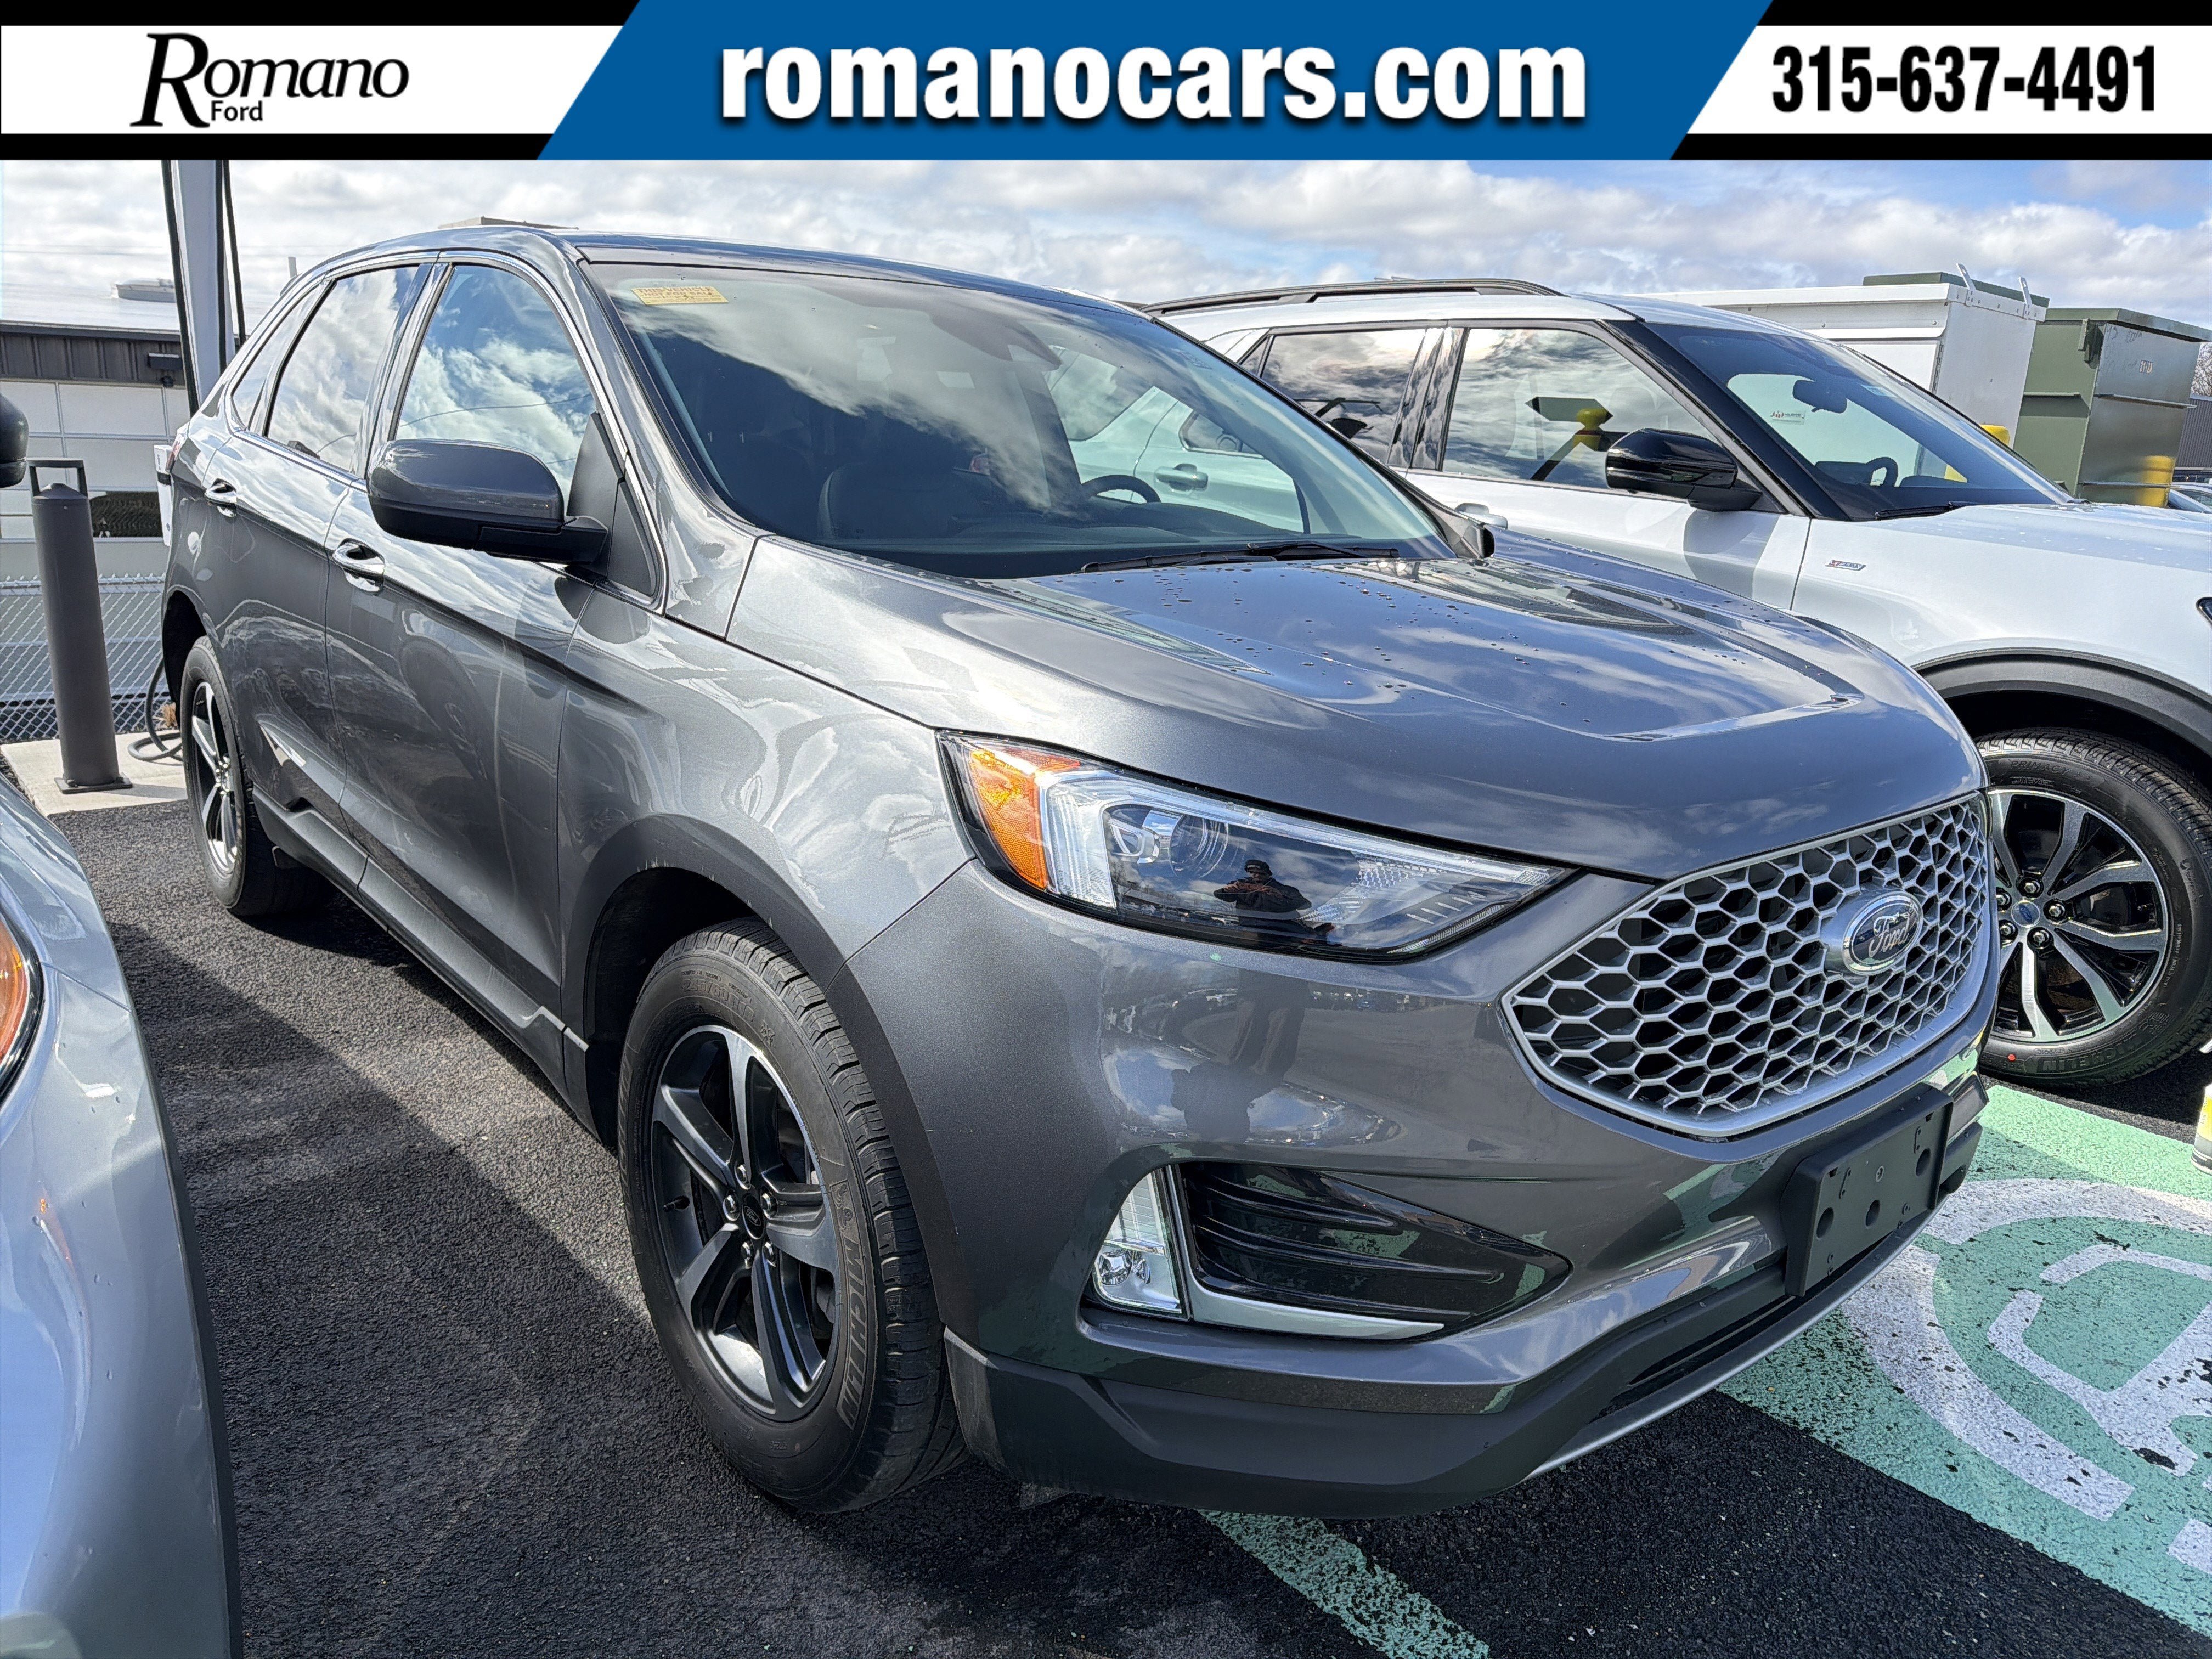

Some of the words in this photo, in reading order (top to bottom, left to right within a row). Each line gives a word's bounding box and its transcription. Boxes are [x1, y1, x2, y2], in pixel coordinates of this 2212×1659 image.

[2010, 760, 2072, 775] PRIMACY
[1868, 911, 1911, 958] Ford
[746, 1208, 758, 1224] Ford
[834, 1235, 867, 1429] MICHELIN
